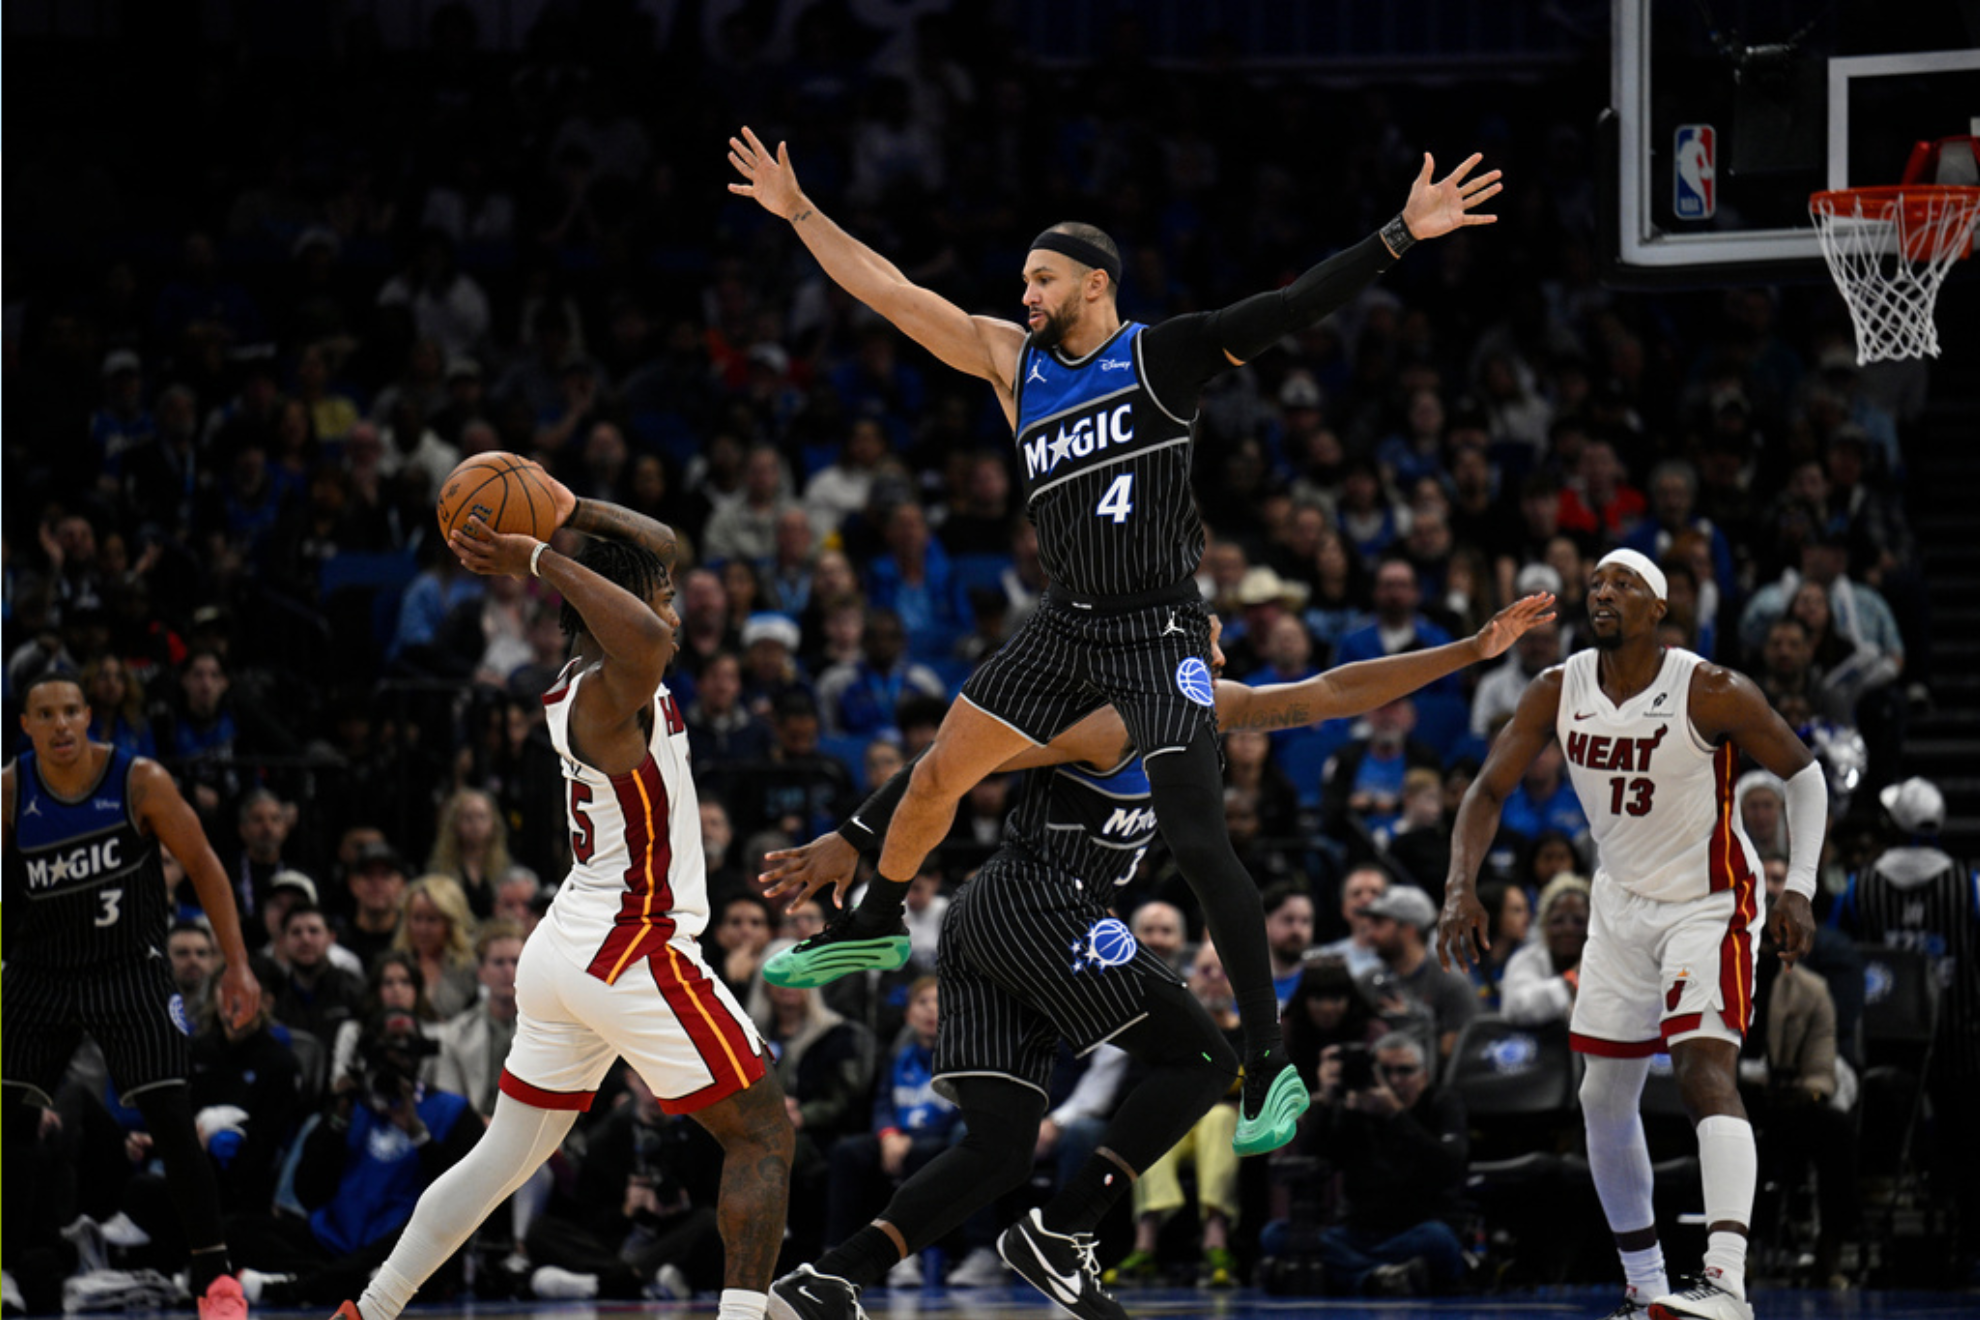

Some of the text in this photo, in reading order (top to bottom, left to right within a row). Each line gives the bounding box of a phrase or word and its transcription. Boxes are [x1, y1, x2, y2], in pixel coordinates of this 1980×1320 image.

[1096, 473, 1134, 524] 4
[1567, 723, 1668, 772] HEAT
[1609, 777, 1655, 817] 13
[94, 889, 122, 927] 3
